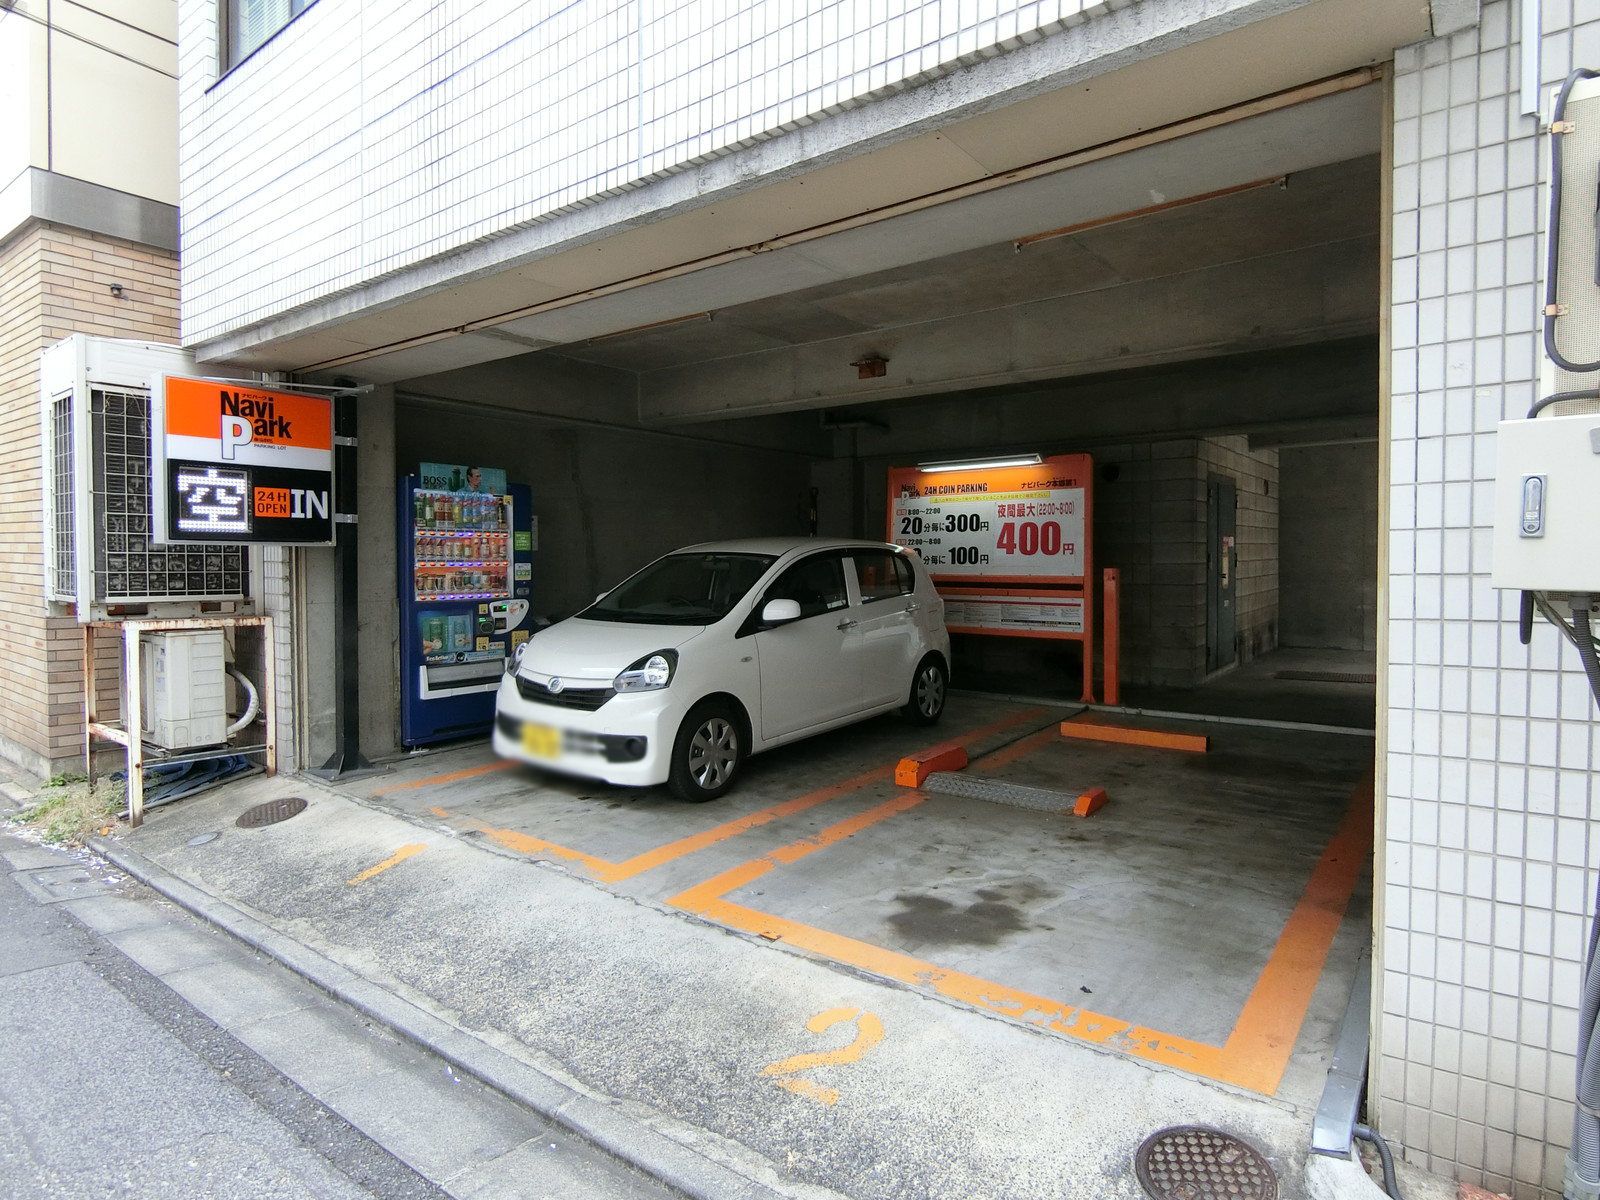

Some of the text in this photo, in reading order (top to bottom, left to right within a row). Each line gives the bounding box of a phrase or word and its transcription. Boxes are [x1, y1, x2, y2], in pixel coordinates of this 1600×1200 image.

[220, 391, 274, 419] Navi
[220, 415, 292, 460] Park
[423, 475, 447, 486] BOSS
[901, 484, 916, 492] Navi
[924, 483, 988, 495] 24H COIN PARKING
[178, 468, 247, 530] 空
[257, 503, 287, 514] OPEN
[291, 489, 328, 520] IN
[996, 521, 1075, 556] 400円
[346, 843, 428, 886] 1
[757, 1007, 885, 1107] 2
